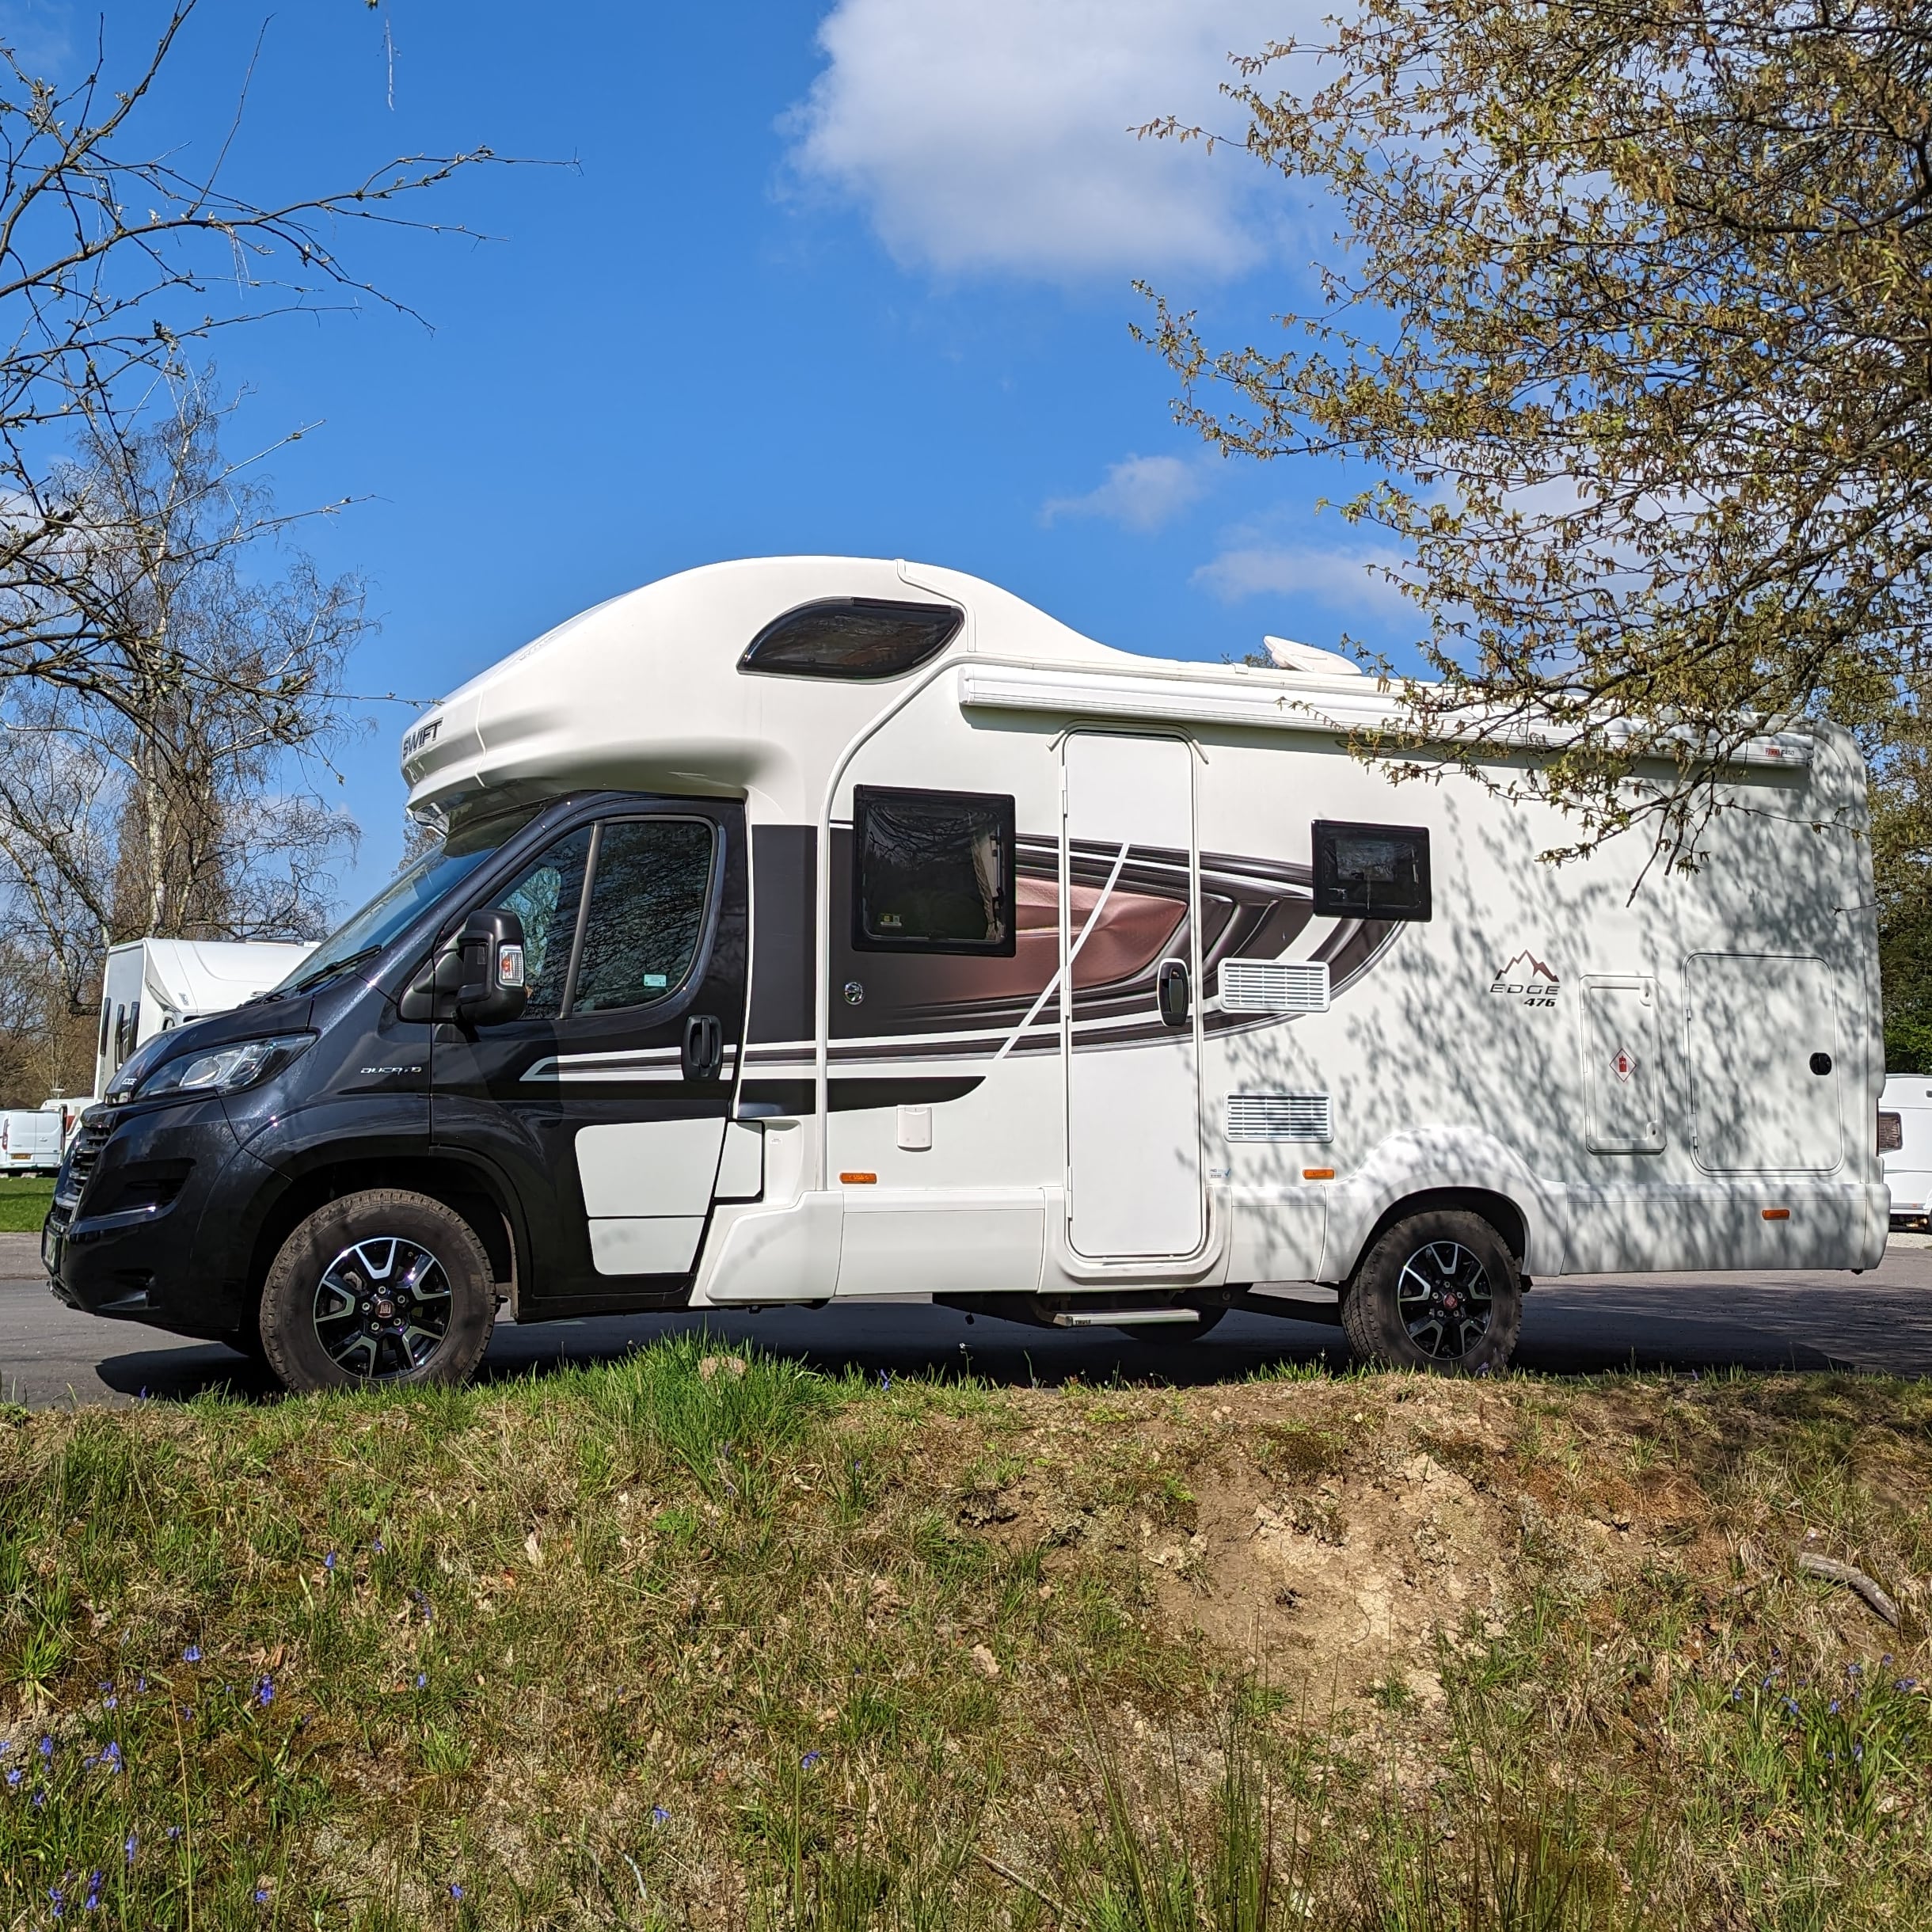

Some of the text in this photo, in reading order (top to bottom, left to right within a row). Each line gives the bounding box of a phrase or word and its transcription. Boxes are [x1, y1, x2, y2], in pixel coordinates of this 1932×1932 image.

[402, 717, 443, 760] SWIFT
[1489, 983, 1561, 995] EDGE
[1523, 998, 1557, 1007] 476
